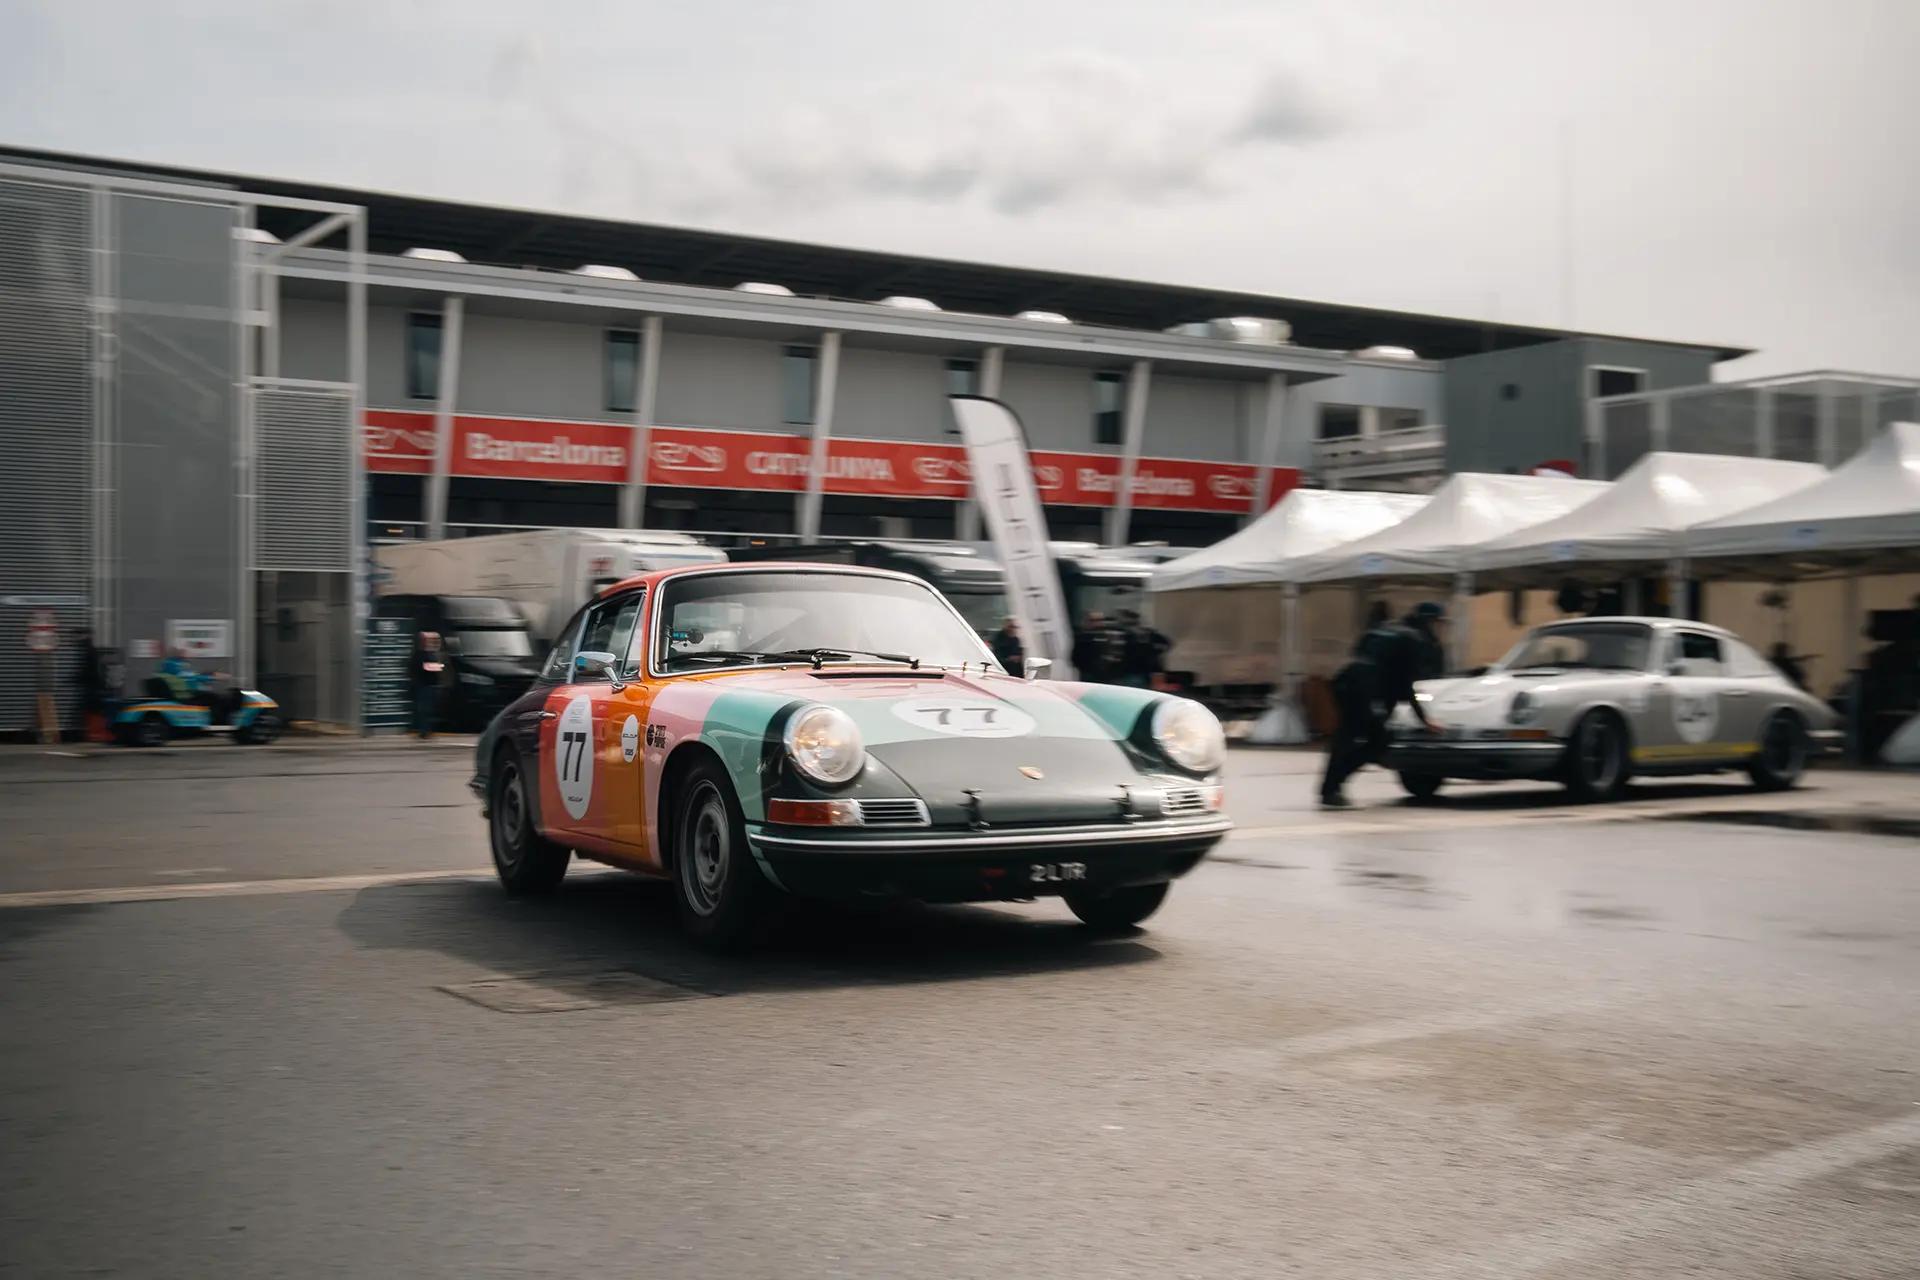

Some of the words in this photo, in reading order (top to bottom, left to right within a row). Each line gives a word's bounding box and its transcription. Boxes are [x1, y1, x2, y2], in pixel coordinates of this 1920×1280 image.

[465, 432, 627, 467] Barcelona
[744, 451, 896, 481] CATAUNYA
[916, 708, 998, 725] 77
[563, 731, 587, 782] 77
